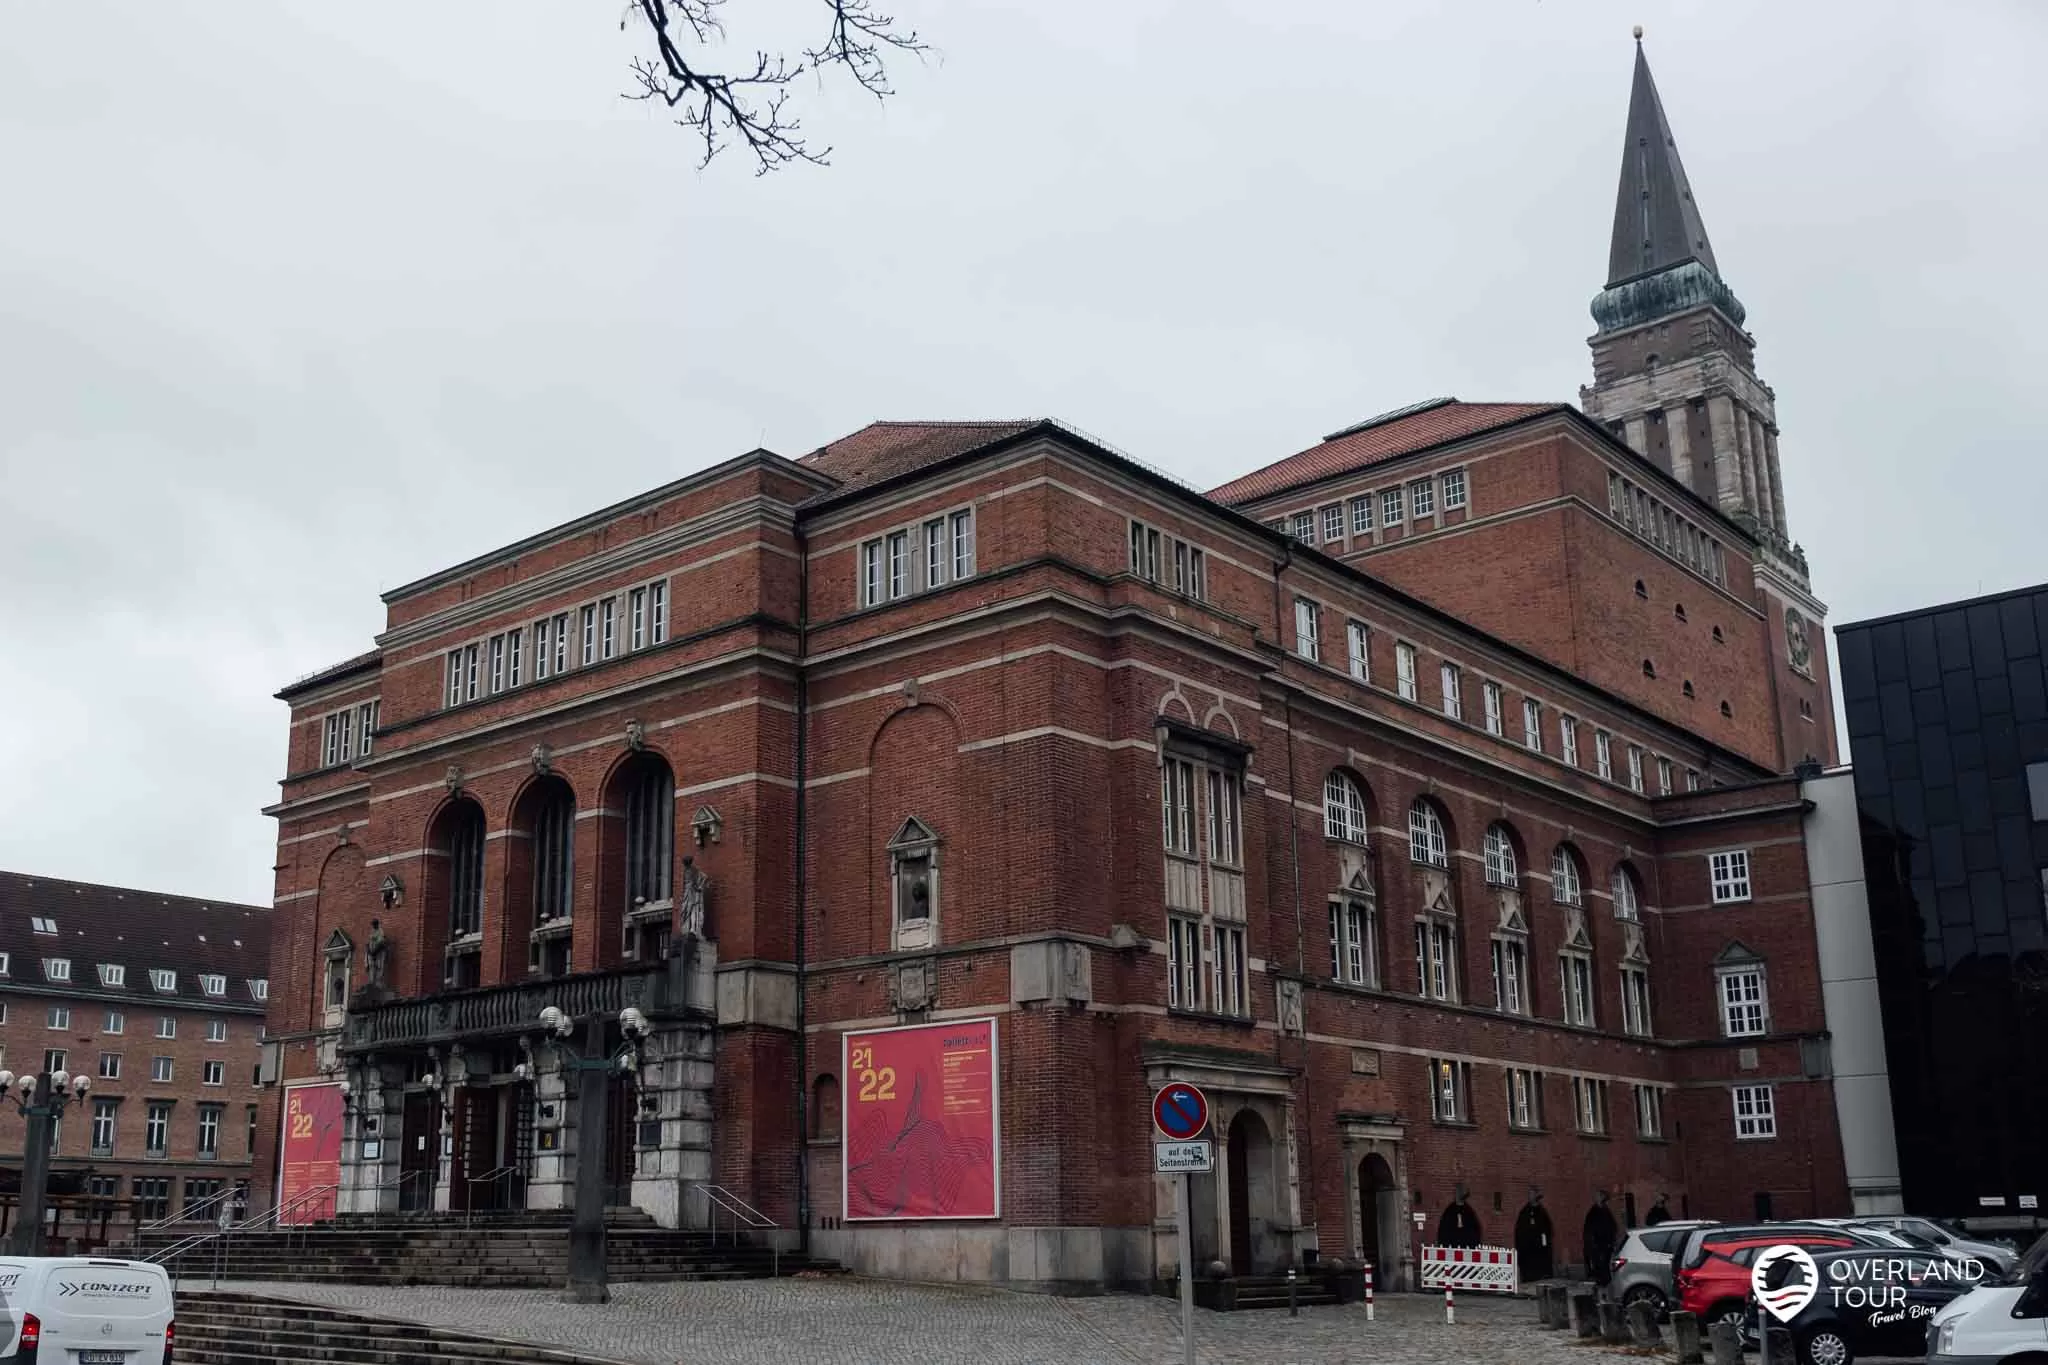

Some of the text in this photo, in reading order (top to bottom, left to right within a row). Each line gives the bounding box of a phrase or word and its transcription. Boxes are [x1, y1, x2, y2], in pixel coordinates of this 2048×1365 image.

[852, 1048, 872, 1069] 21
[859, 1067, 896, 1101] 22
[289, 1098, 302, 1114] 21
[291, 1113, 313, 1138] 22
[1168, 1148, 1180, 1156] auf
